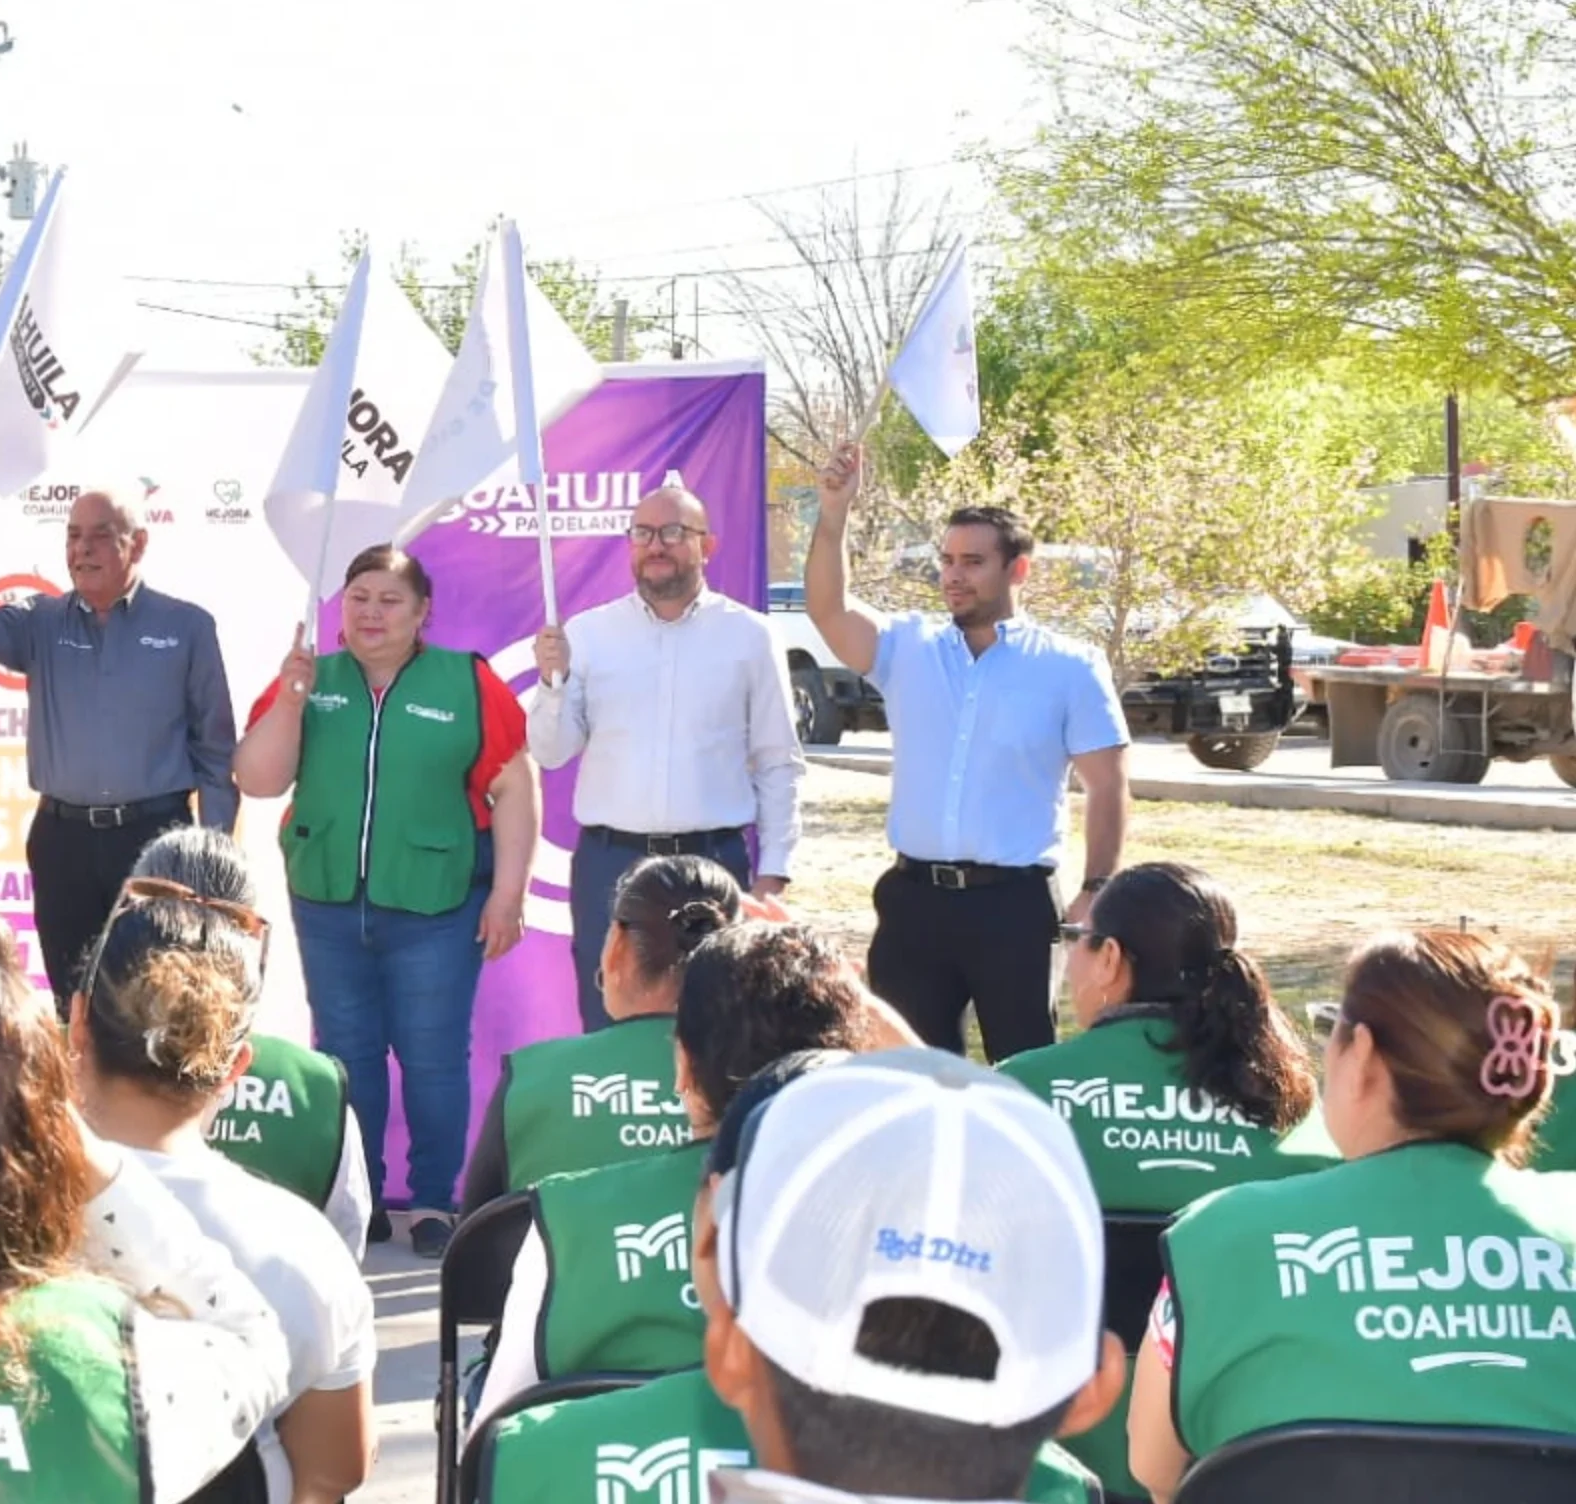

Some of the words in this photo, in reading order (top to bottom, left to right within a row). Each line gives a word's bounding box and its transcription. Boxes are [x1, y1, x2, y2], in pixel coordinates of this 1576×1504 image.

[551, 515, 631, 532] DELANT
[1103, 1126, 1251, 1157] COAHUILA
[929, 1237, 991, 1273] Dirt
[1273, 1226, 1576, 1298] MEJOR
[1355, 1304, 1576, 1340] COAHUILA
